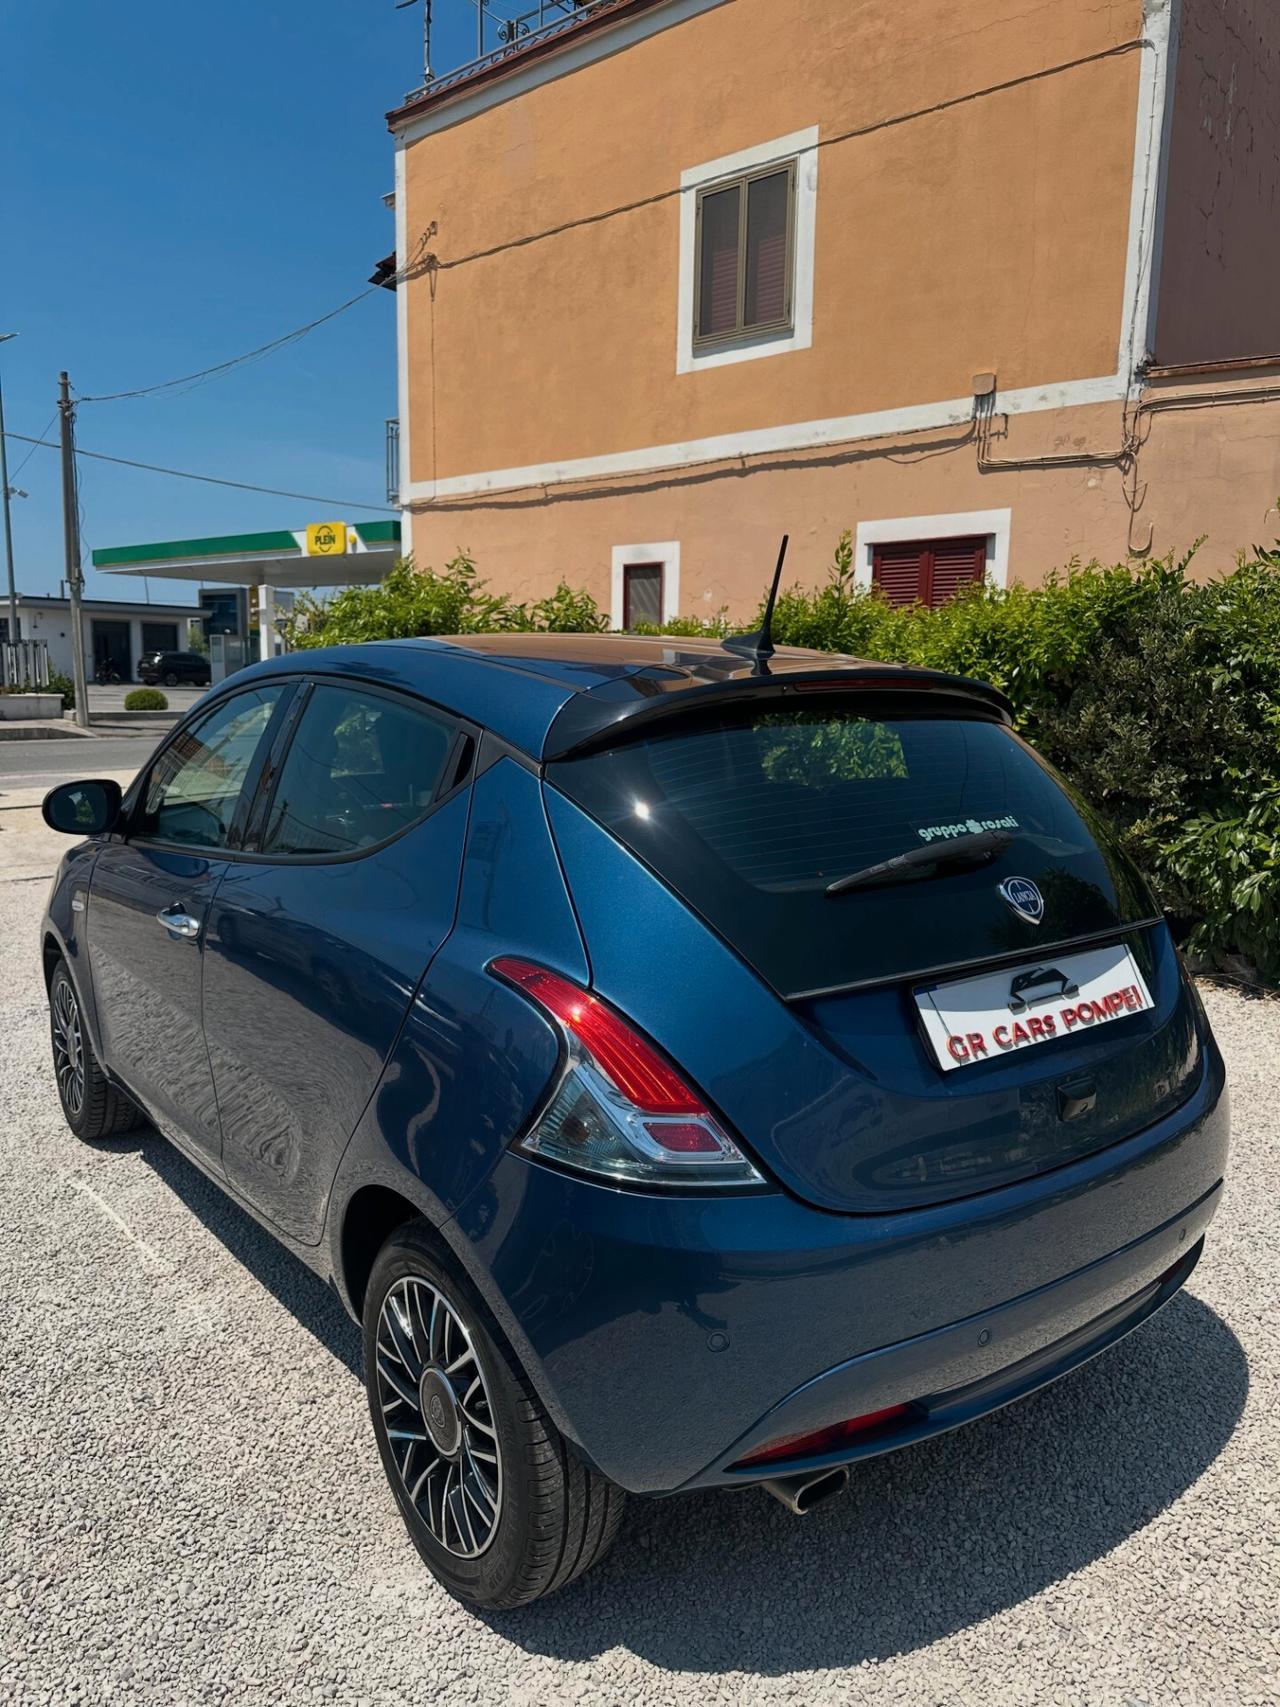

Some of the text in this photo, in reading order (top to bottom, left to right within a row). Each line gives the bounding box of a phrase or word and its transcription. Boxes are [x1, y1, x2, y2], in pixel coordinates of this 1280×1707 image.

[918, 815, 1019, 841] gruppo rosati
[947, 985, 1143, 1061] GR CARS POMPEI
